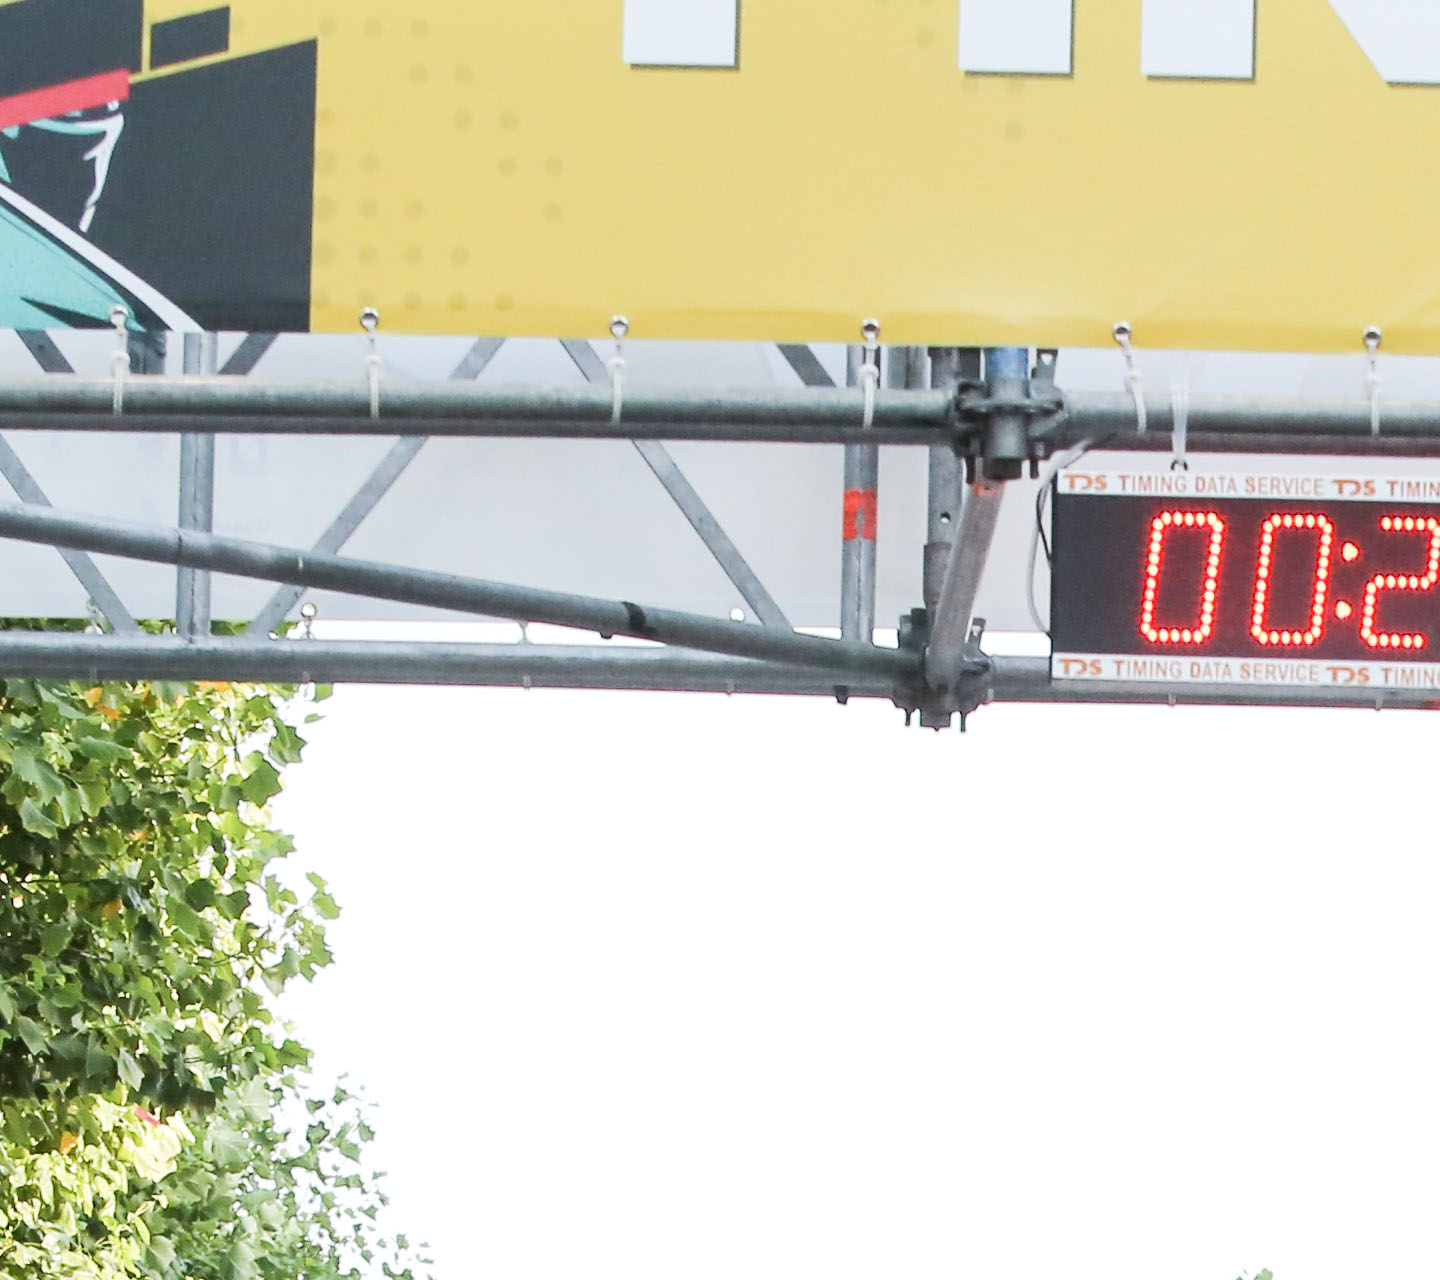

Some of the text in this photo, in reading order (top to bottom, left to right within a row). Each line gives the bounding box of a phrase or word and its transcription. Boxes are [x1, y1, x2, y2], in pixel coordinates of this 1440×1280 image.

[1119, 475, 1188, 494] TIMING
[1195, 476, 1238, 495] DATA
[1245, 477, 1325, 497] SERVICE
[1114, 659, 1183, 679] TIMING
[1190, 661, 1233, 680] DATA
[1240, 662, 1319, 682] SERVICE
